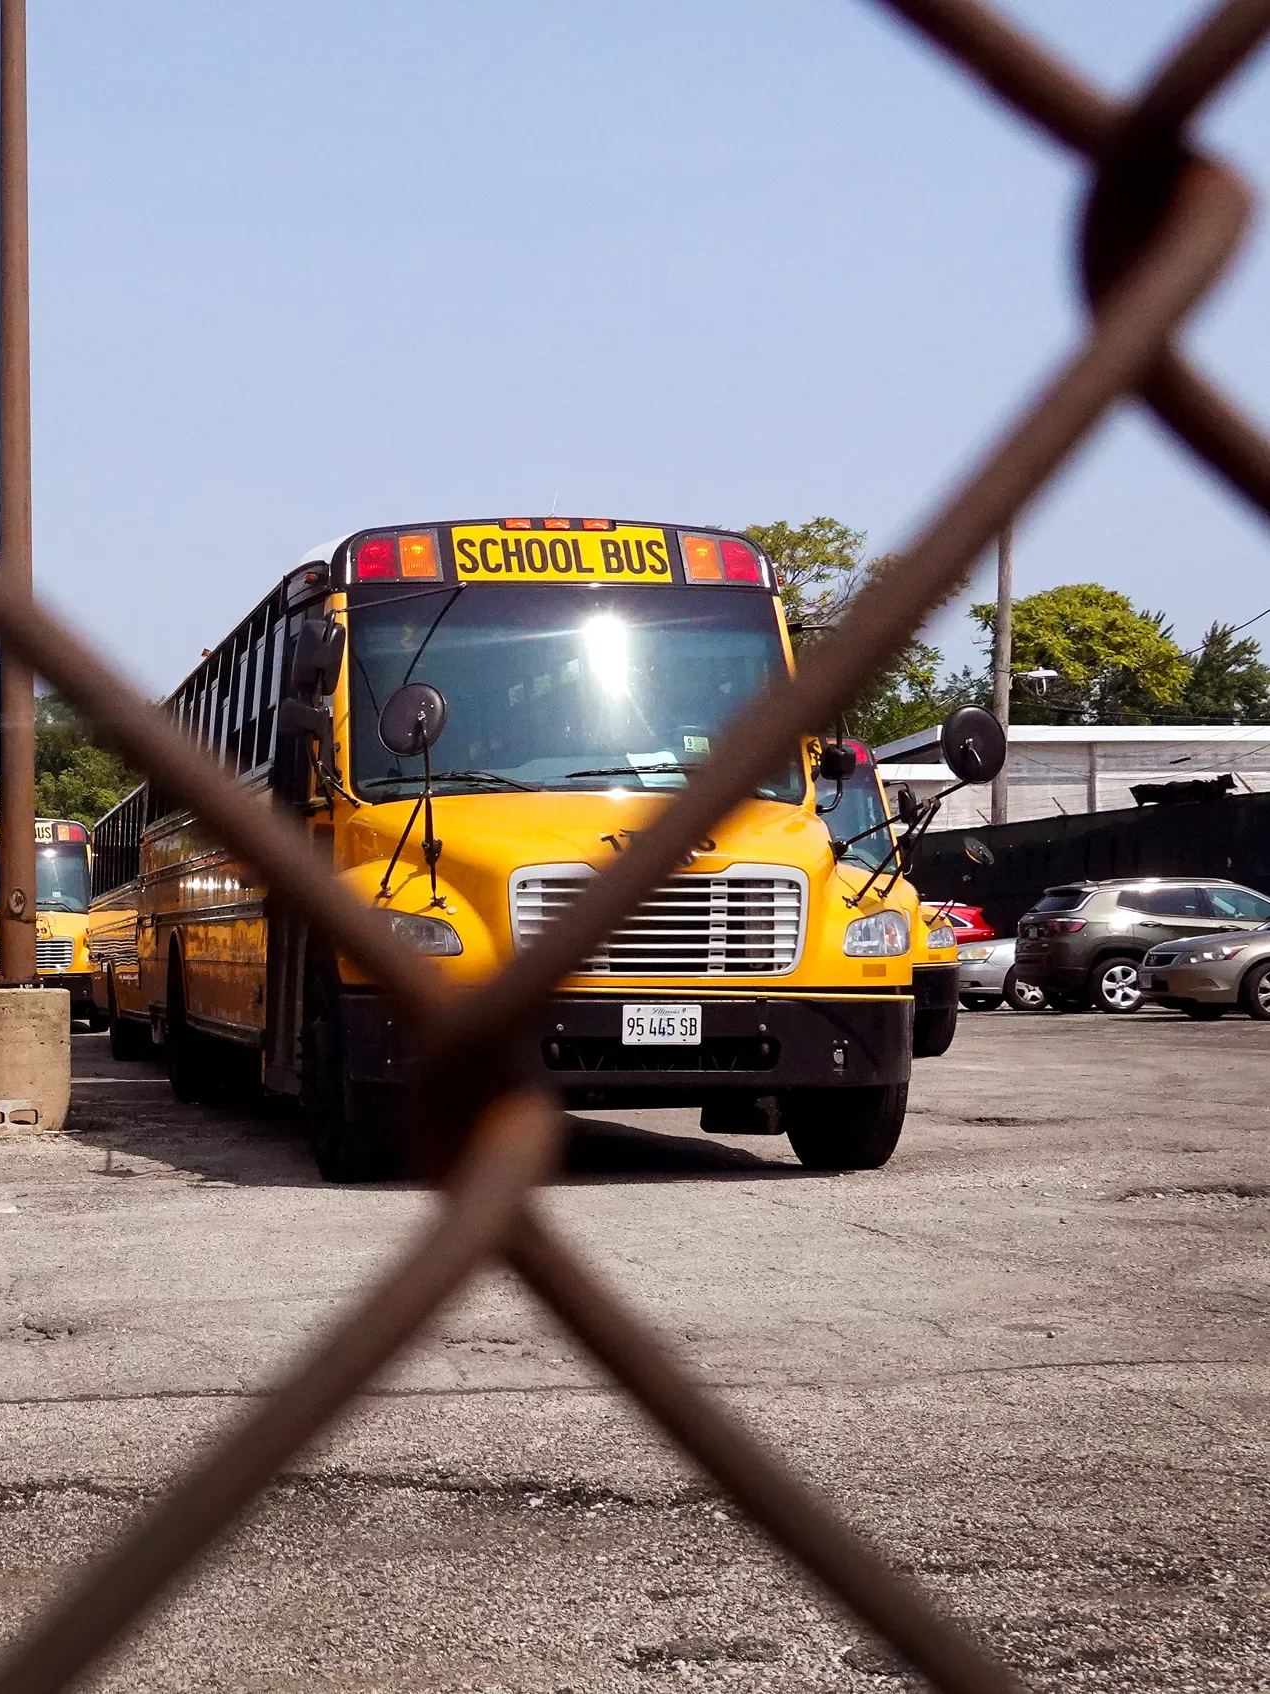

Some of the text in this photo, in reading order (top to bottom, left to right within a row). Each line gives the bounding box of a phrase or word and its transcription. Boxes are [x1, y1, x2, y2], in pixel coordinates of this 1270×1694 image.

[456, 538, 668, 574] SCHOOL BUS
[34, 826, 52, 839] US
[627, 1017, 698, 1037] 95 445 SB
